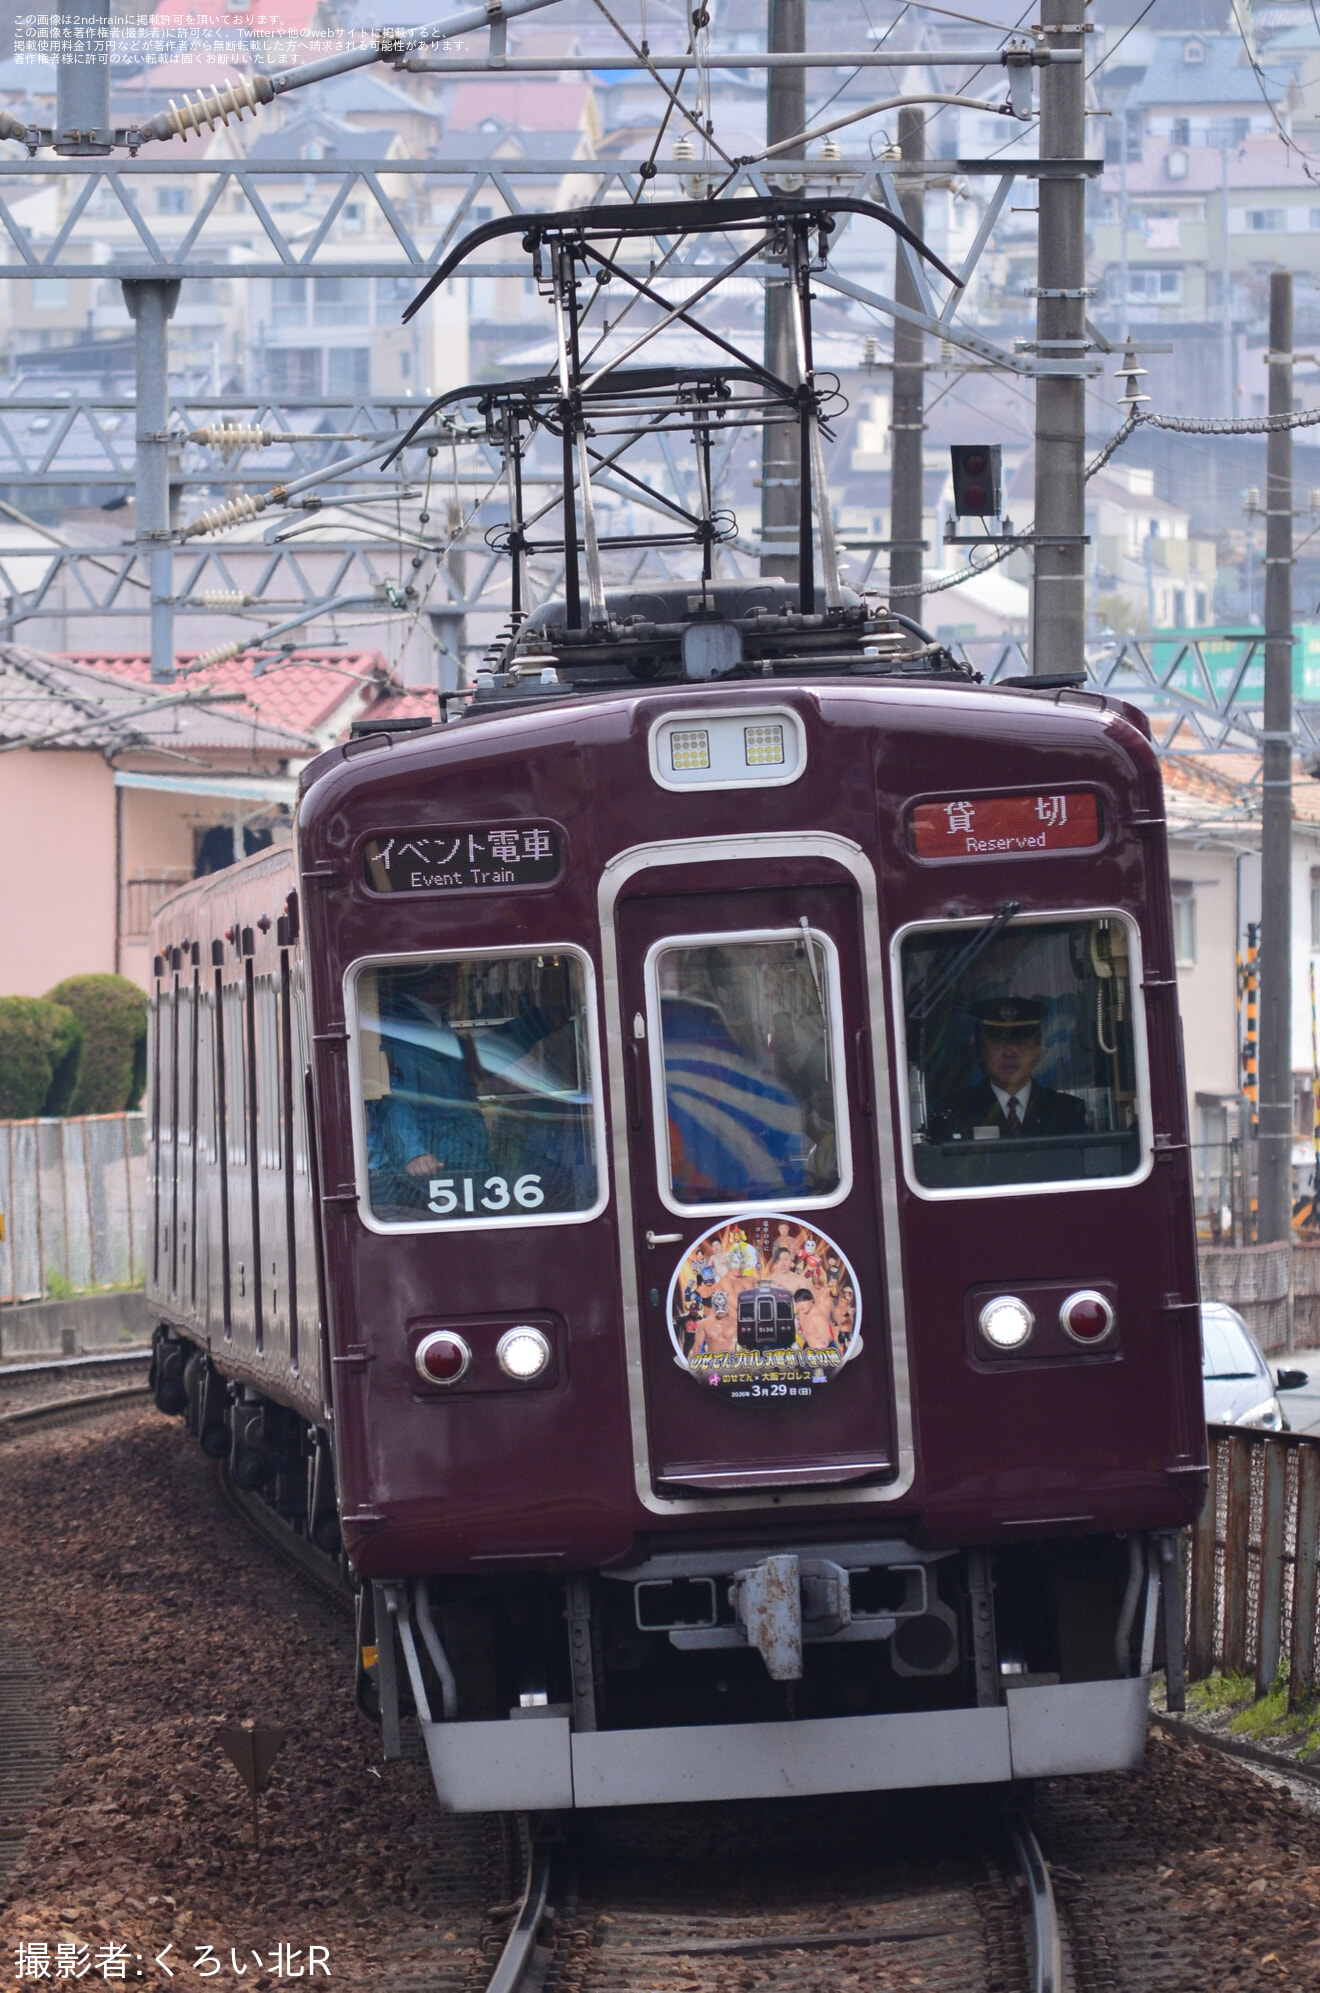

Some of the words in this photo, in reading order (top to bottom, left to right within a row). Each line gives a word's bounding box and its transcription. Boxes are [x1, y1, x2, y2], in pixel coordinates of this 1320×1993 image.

[371, 828, 553, 869] イベント電車
[966, 832, 1046, 852] Reserved
[411, 871, 463, 888] Event
[470, 867, 515, 884] Train
[427, 1174, 545, 1214] 5136
